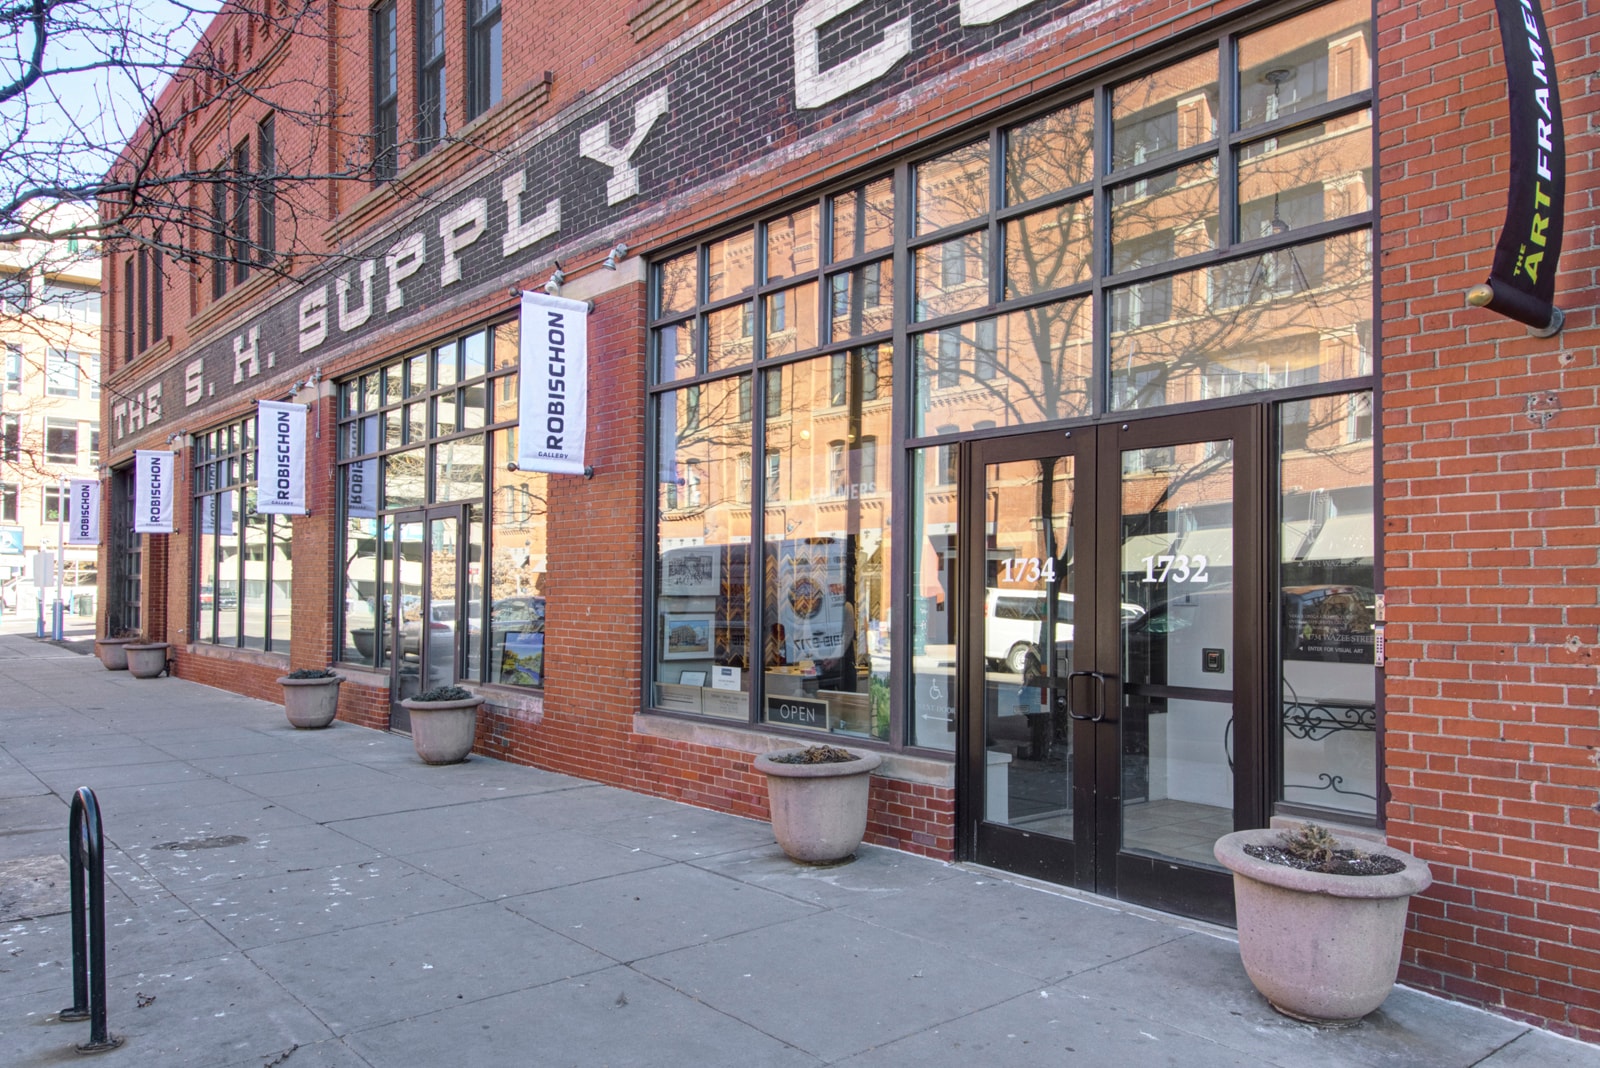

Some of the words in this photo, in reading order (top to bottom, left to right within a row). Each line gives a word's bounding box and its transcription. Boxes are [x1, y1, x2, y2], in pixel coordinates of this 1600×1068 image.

[114, 382, 162, 439] THE
[185, 358, 216, 406] S.
[233, 325, 276, 384] H.
[299, 86, 669, 353] SUPPLY
[1513, 243, 1526, 276] THE
[547, 312, 565, 450] ROBISCHON
[277, 411, 290, 500] ROBISCHON
[538, 451, 568, 459] GALLERY
[150, 457, 161, 522] ROBISCHON
[81, 485, 90, 537] ROBISCHON
[1001, 556, 1056, 583] 1734
[1141, 554, 1208, 583] 1732
[780, 704, 815, 722] OPEN
